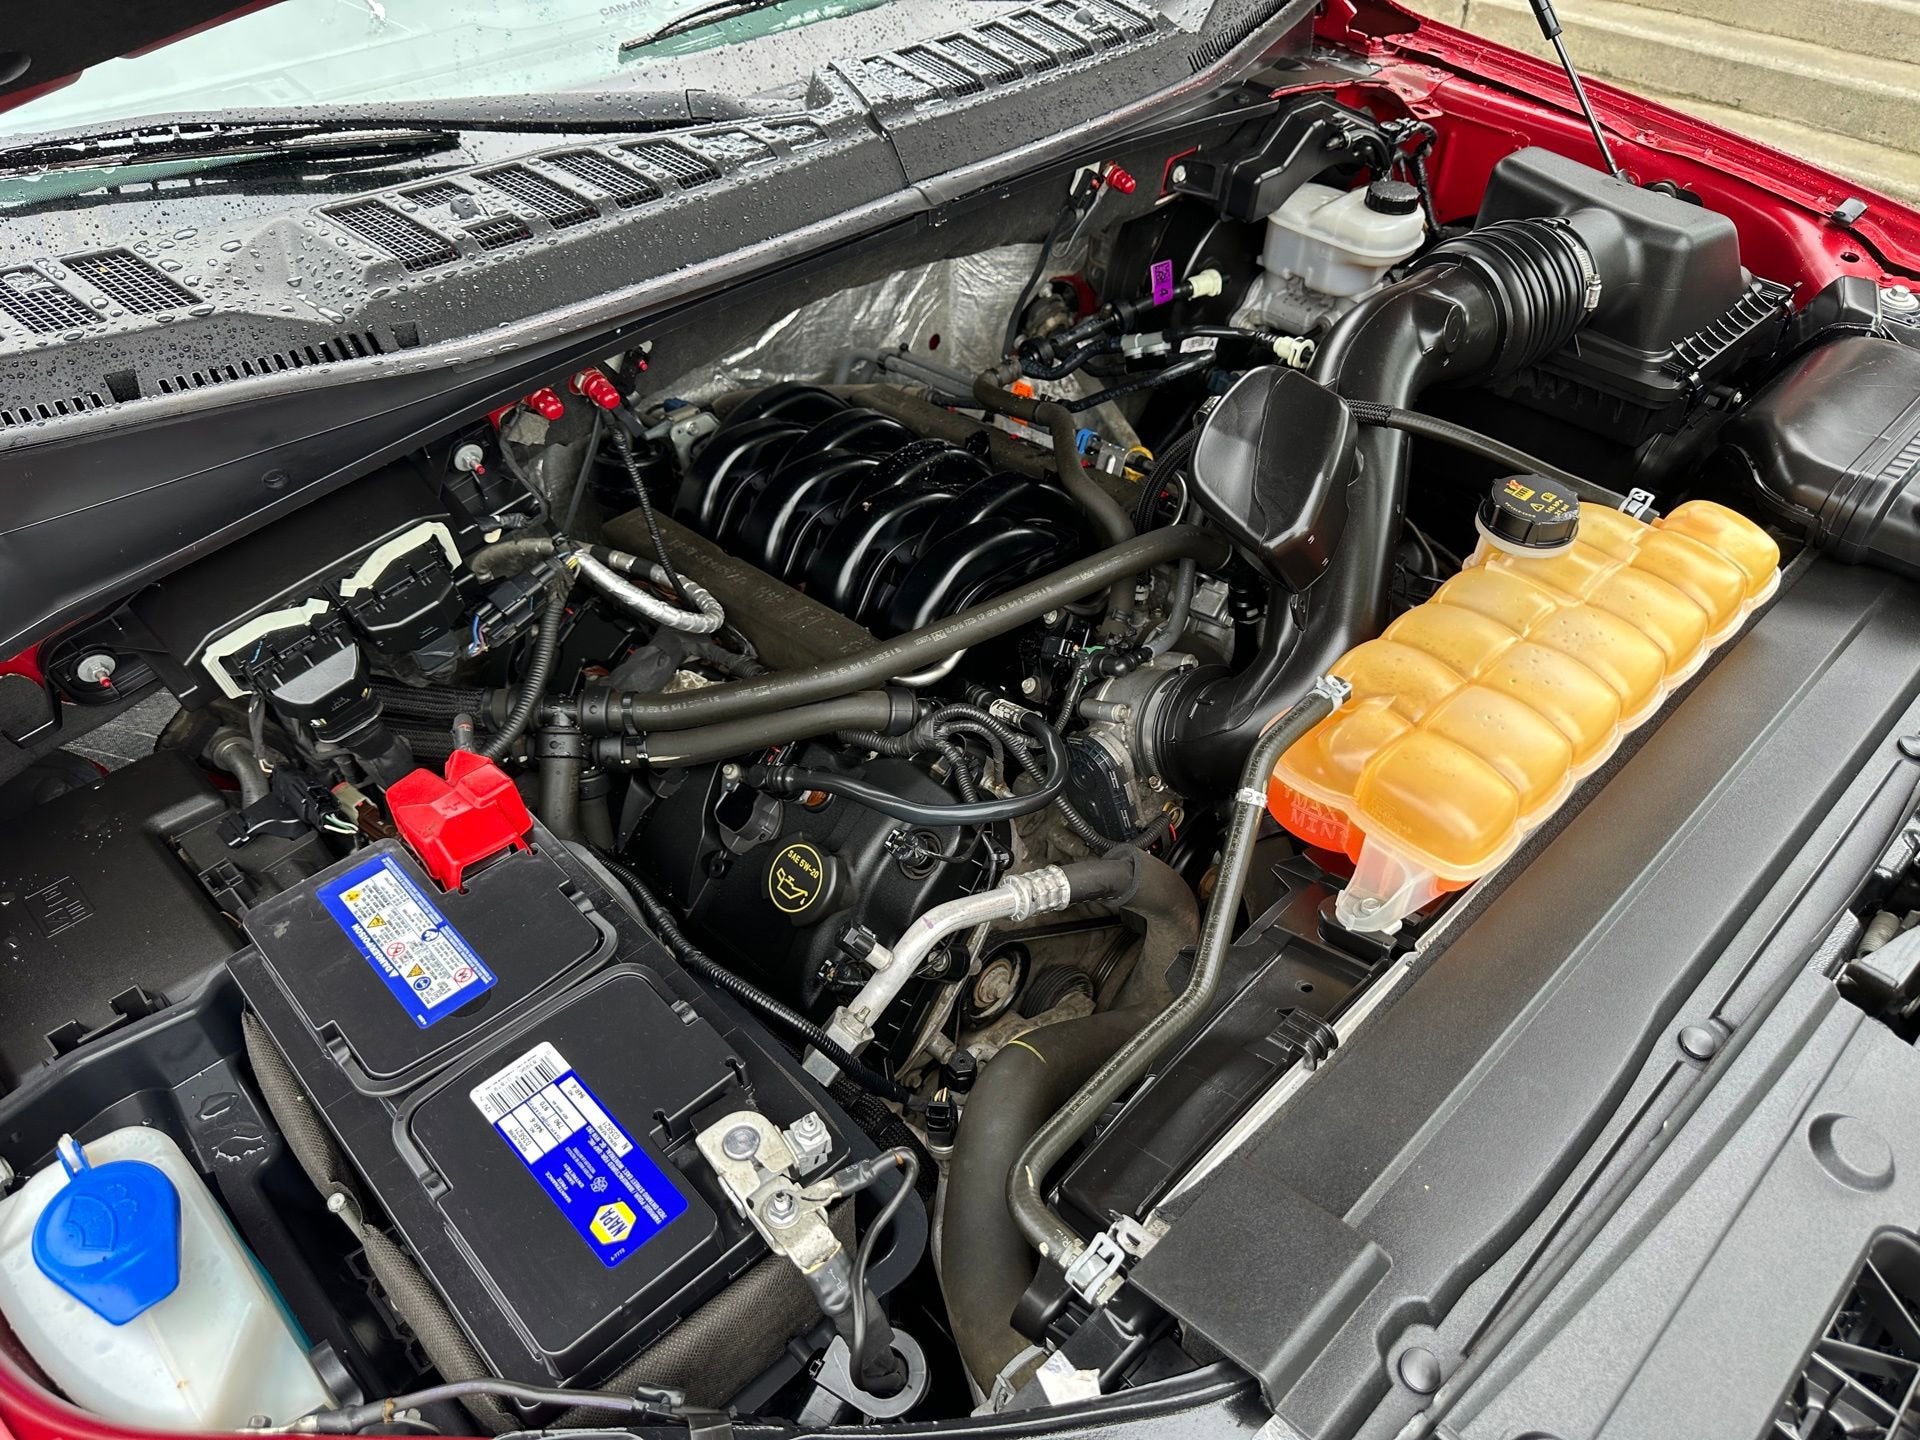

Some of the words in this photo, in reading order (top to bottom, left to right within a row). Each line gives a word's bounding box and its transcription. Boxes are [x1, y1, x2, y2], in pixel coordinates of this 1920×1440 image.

[1290, 808, 1337, 839] MIN
[787, 850, 801, 864] SAE
[799, 859, 820, 879] 5W-20
[602, 1119, 620, 1140] 035821
[544, 1170, 572, 1203] MAINTENANCE
[556, 1176, 568, 1190] FREE
[598, 1206, 627, 1237] NAPA
